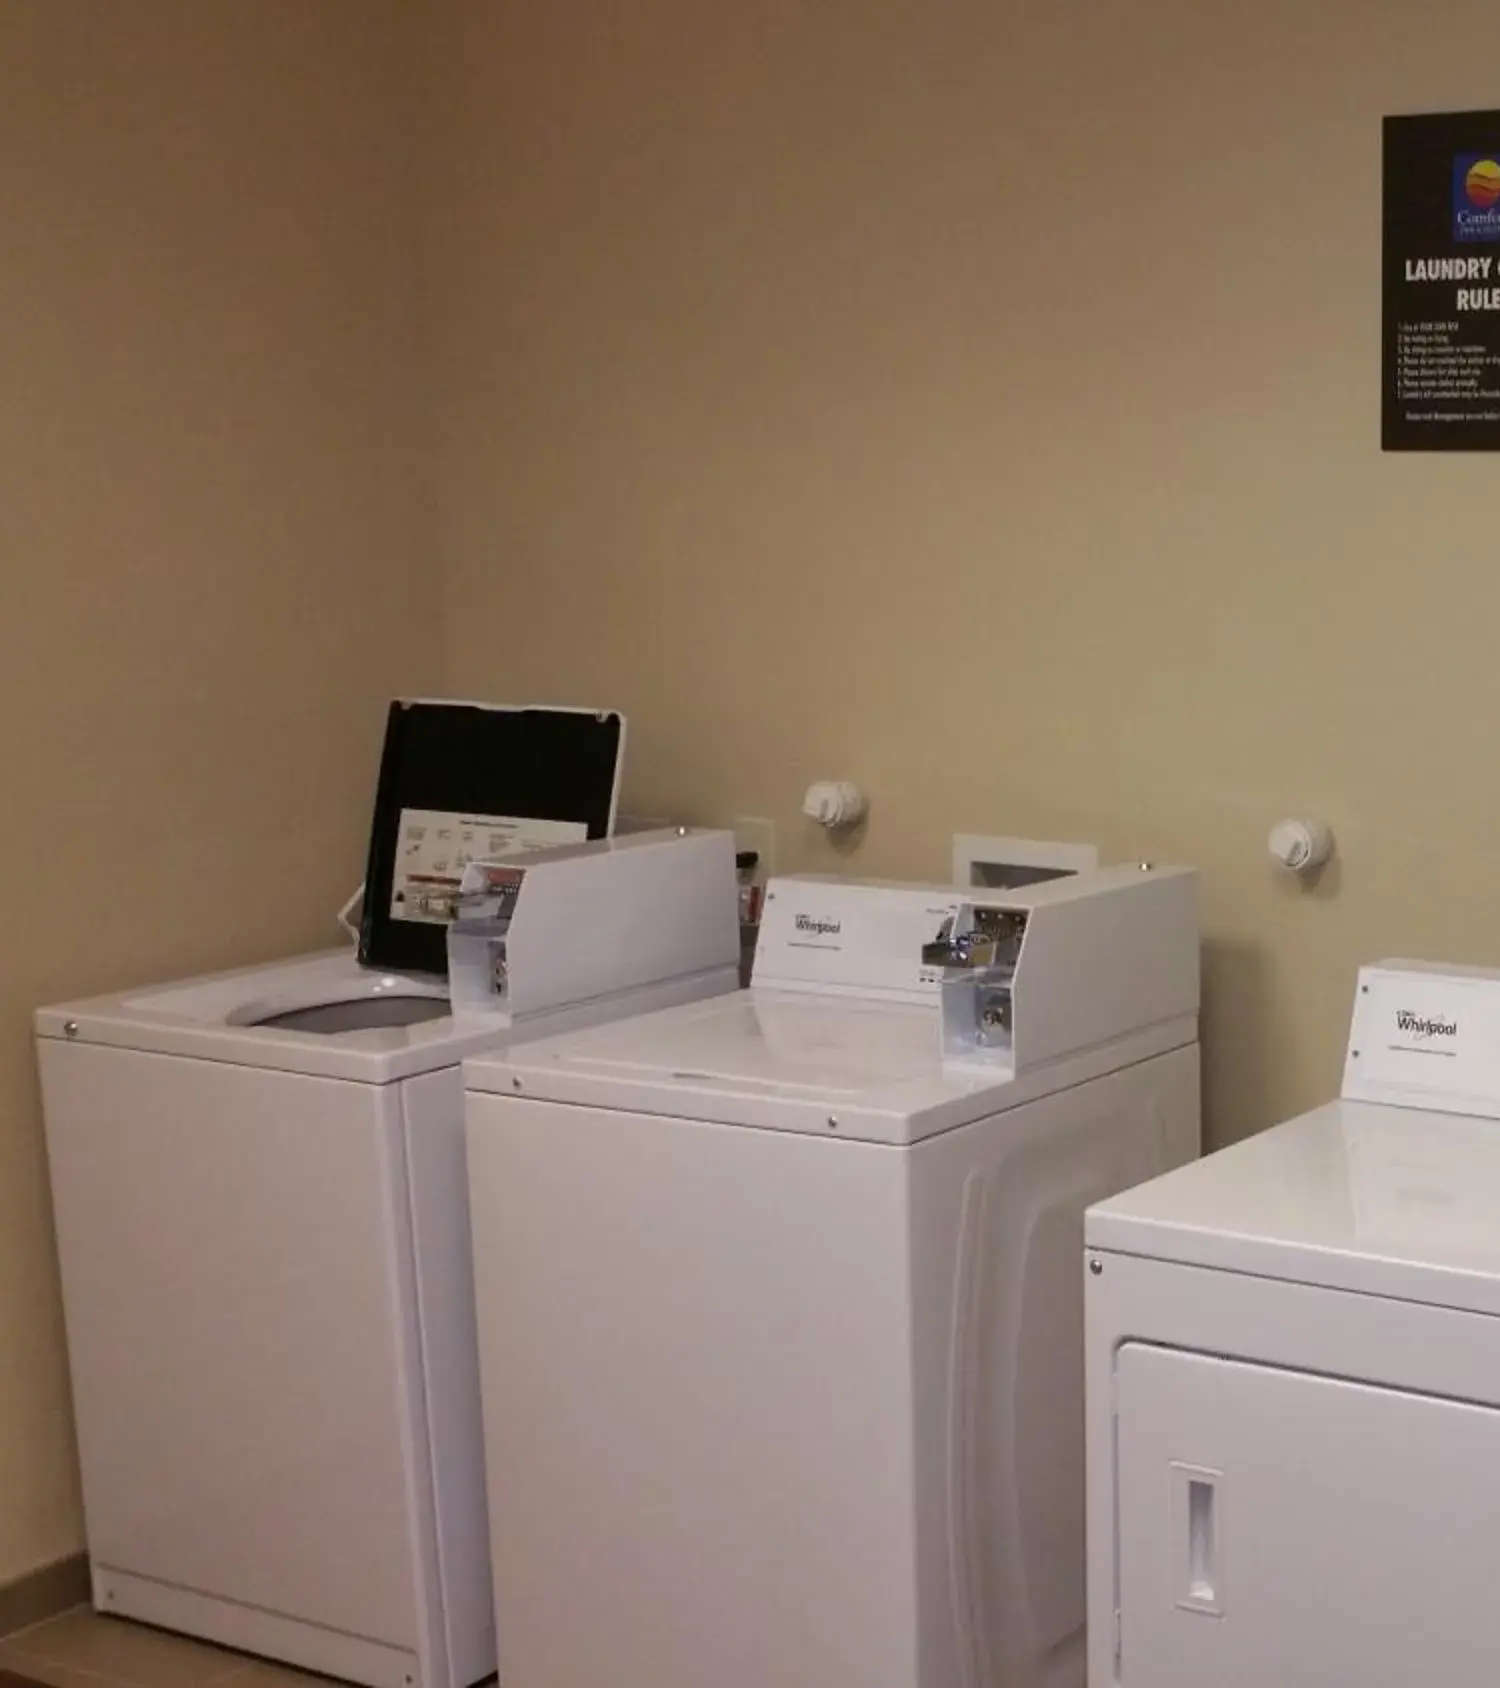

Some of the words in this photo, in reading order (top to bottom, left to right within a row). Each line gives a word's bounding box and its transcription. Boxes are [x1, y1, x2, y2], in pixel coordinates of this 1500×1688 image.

[1405, 256, 1492, 281] LAUNDRY
[795, 918, 841, 934] Whirlpool
[1397, 1016, 1457, 1037] Whirlpool
